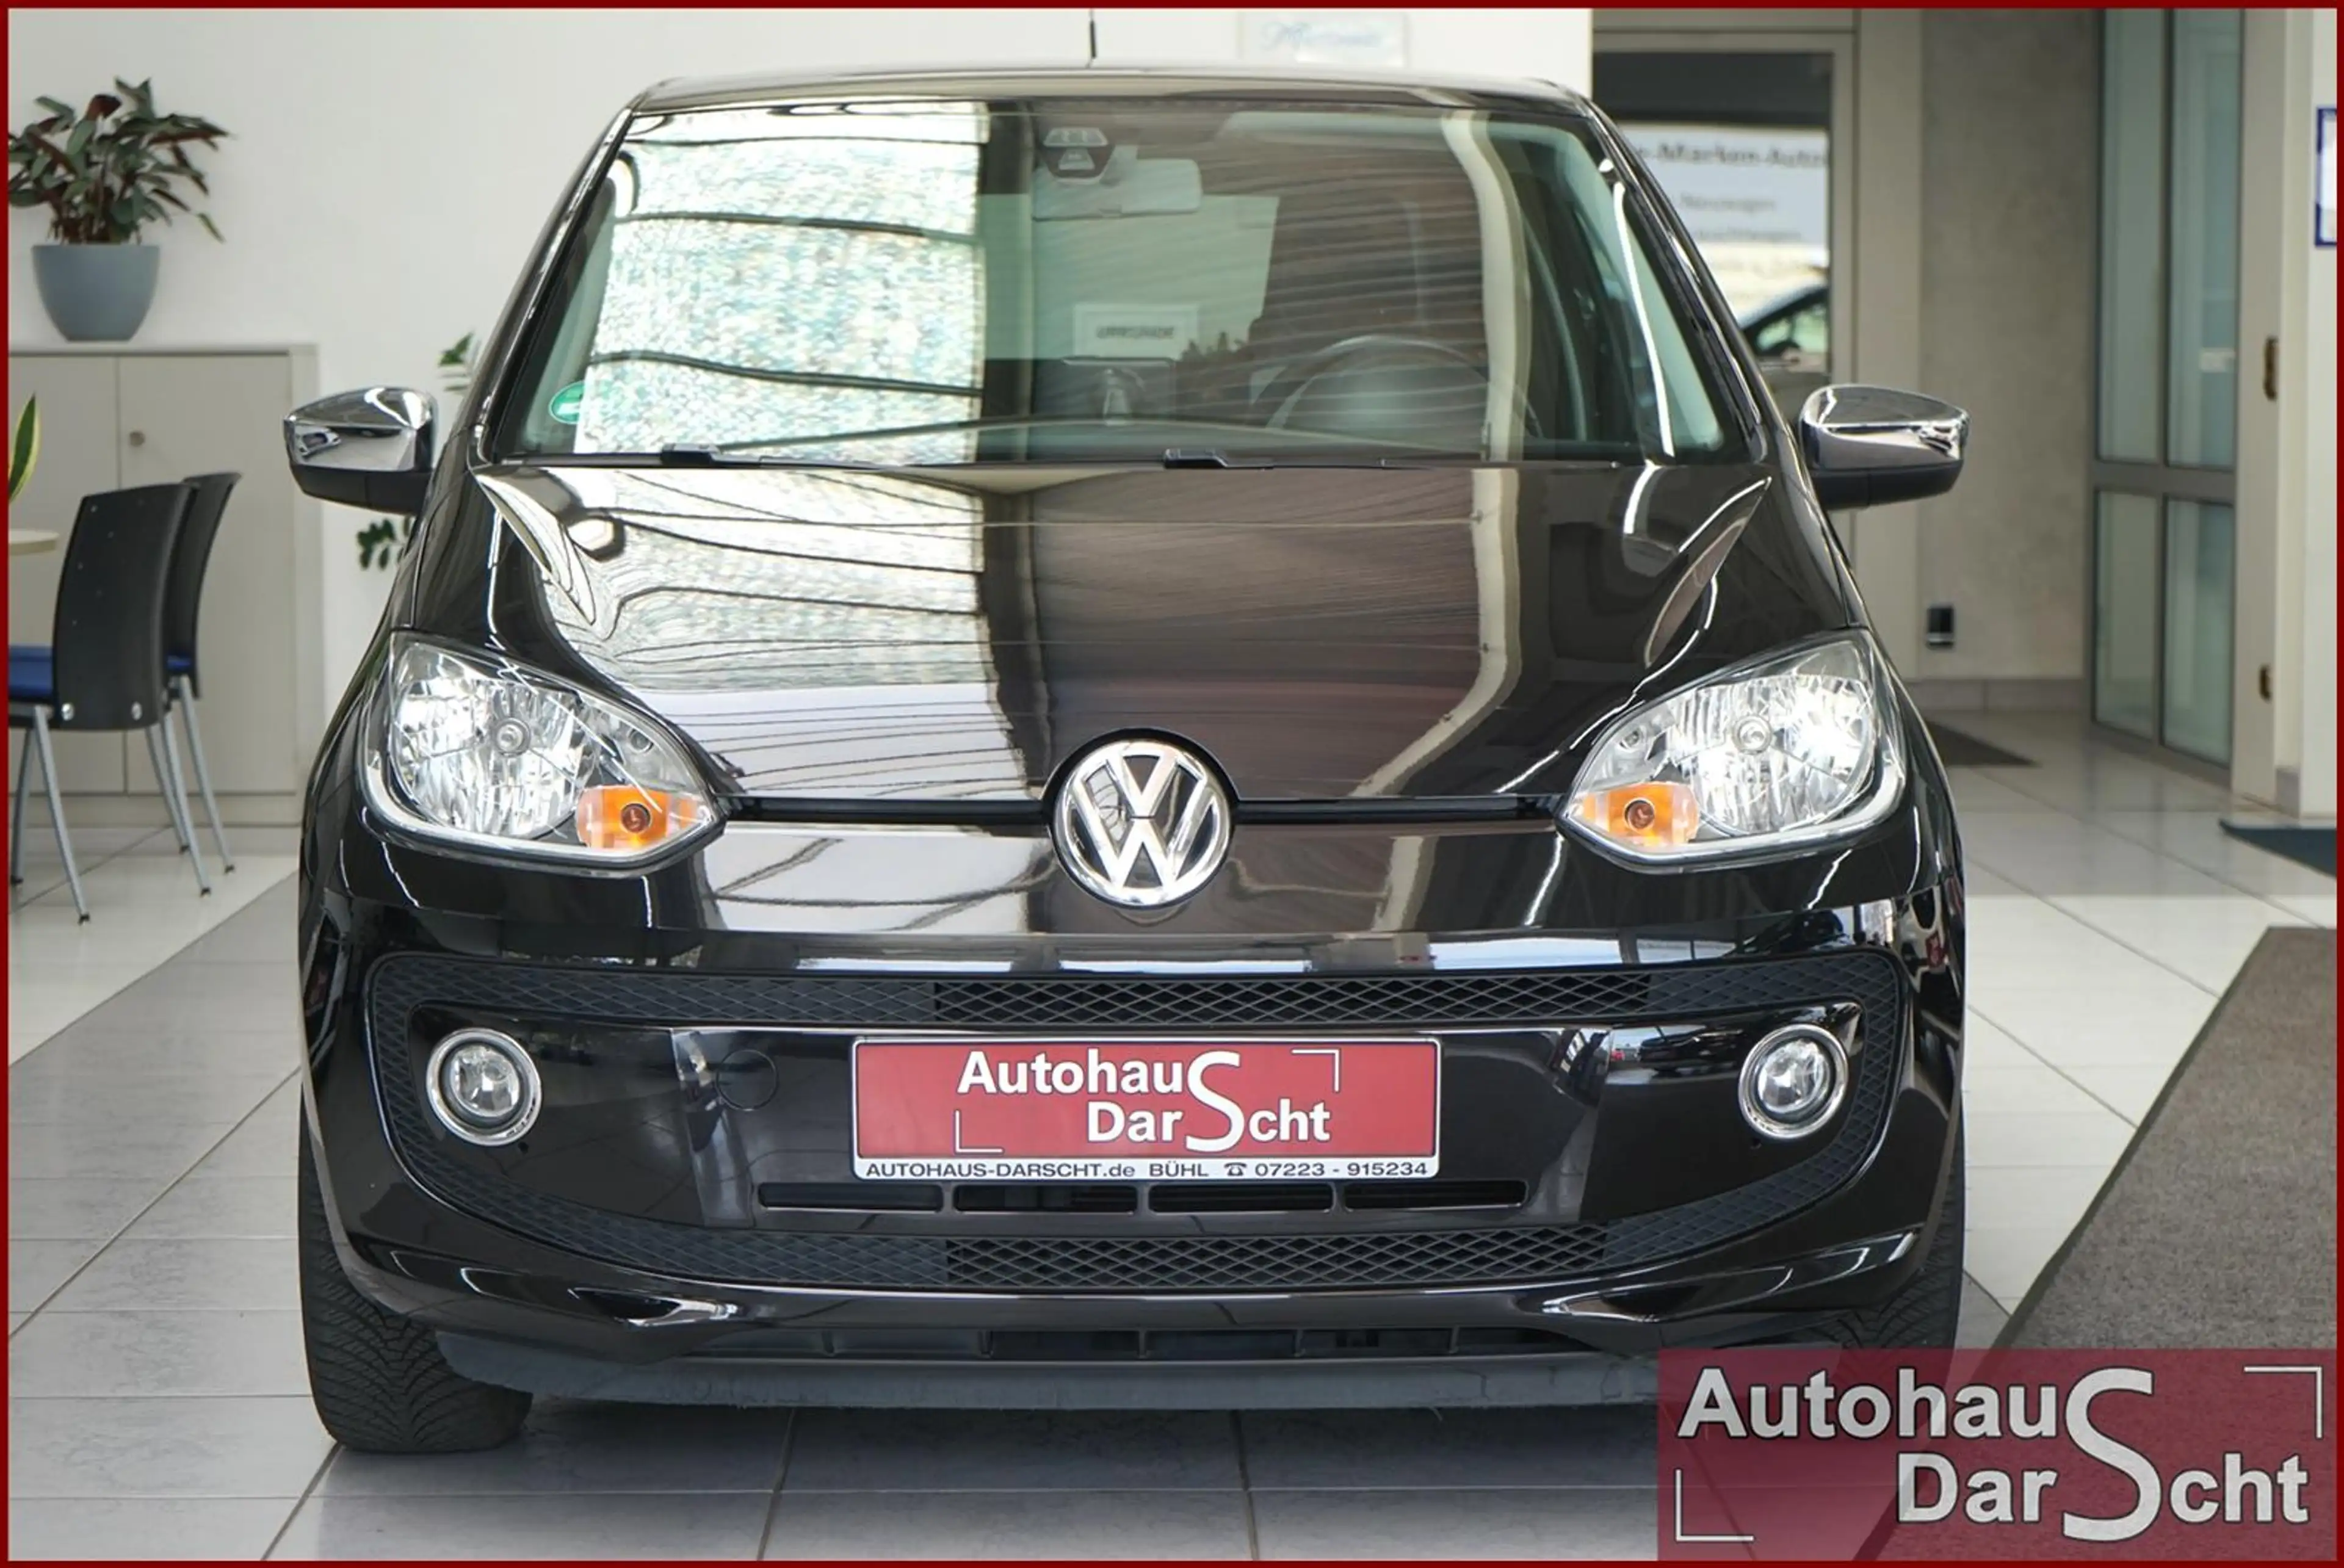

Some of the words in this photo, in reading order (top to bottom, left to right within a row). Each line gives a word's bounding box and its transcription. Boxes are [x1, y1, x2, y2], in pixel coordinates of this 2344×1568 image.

[866, 1163, 1136, 1178] AUTOHAUS-DARSCHT.de
[1149, 1160, 1209, 1178] BÜHL
[1254, 1162, 1325, 1177] 07223
[1347, 1162, 1428, 1177] 915234
